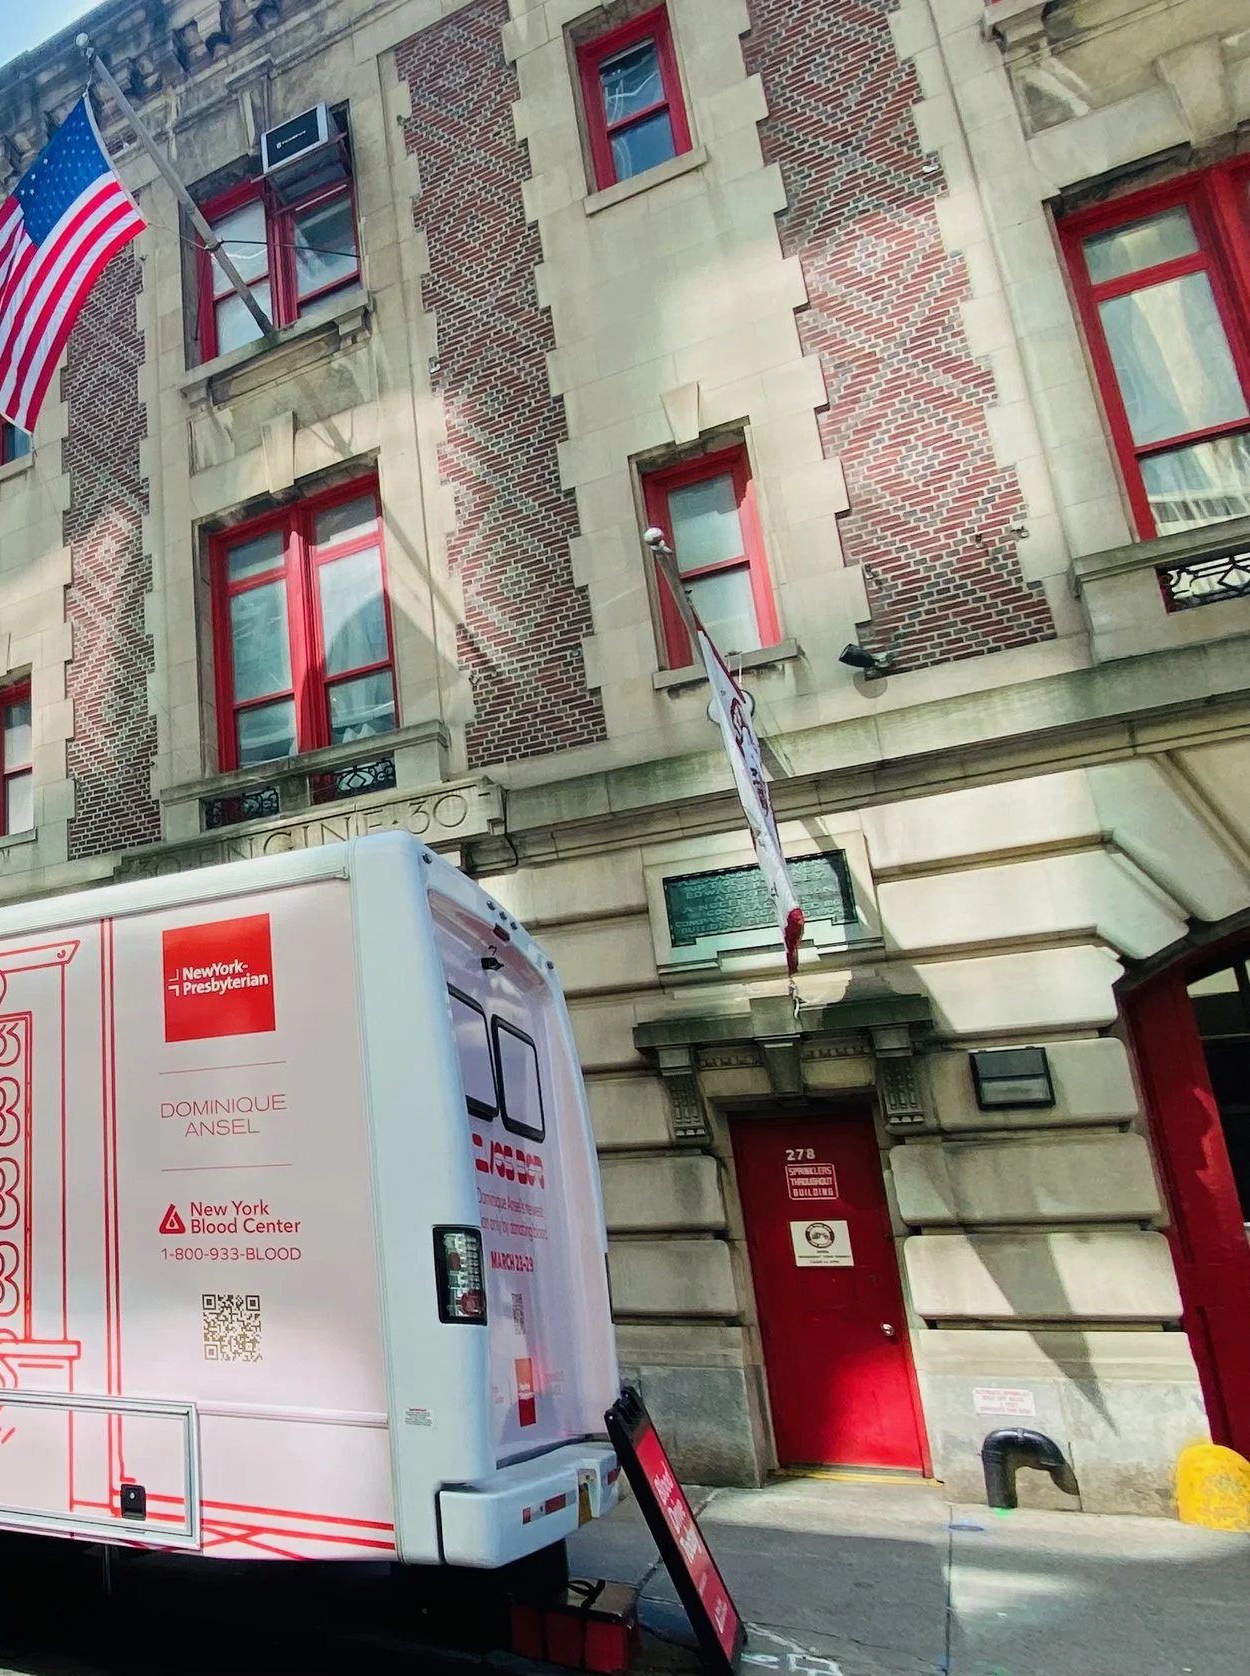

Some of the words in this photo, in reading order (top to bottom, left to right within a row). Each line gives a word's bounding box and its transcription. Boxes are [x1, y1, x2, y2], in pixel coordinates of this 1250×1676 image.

[407, 794, 468, 835] 30
[182, 959, 249, 981] NewYork-
[182, 973, 269, 995] Presbyterian
[160, 1094, 288, 1119] DOMINIQUE
[184, 1118, 261, 1138] ANSEL
[785, 1148, 816, 1161] 278
[788, 1166, 833, 1176] SPRINKLERS
[790, 1176, 834, 1186] THROUGHOUT
[793, 1187, 835, 1197] BUILDING
[190, 1201, 228, 1217] New
[231, 1199, 270, 1216] York
[191, 1217, 238, 1235] Blood
[242, 1217, 302, 1234] Center
[160, 1247, 302, 1261] 1-800-933-BLOOD
[490, 1251, 516, 1272] MARCH
